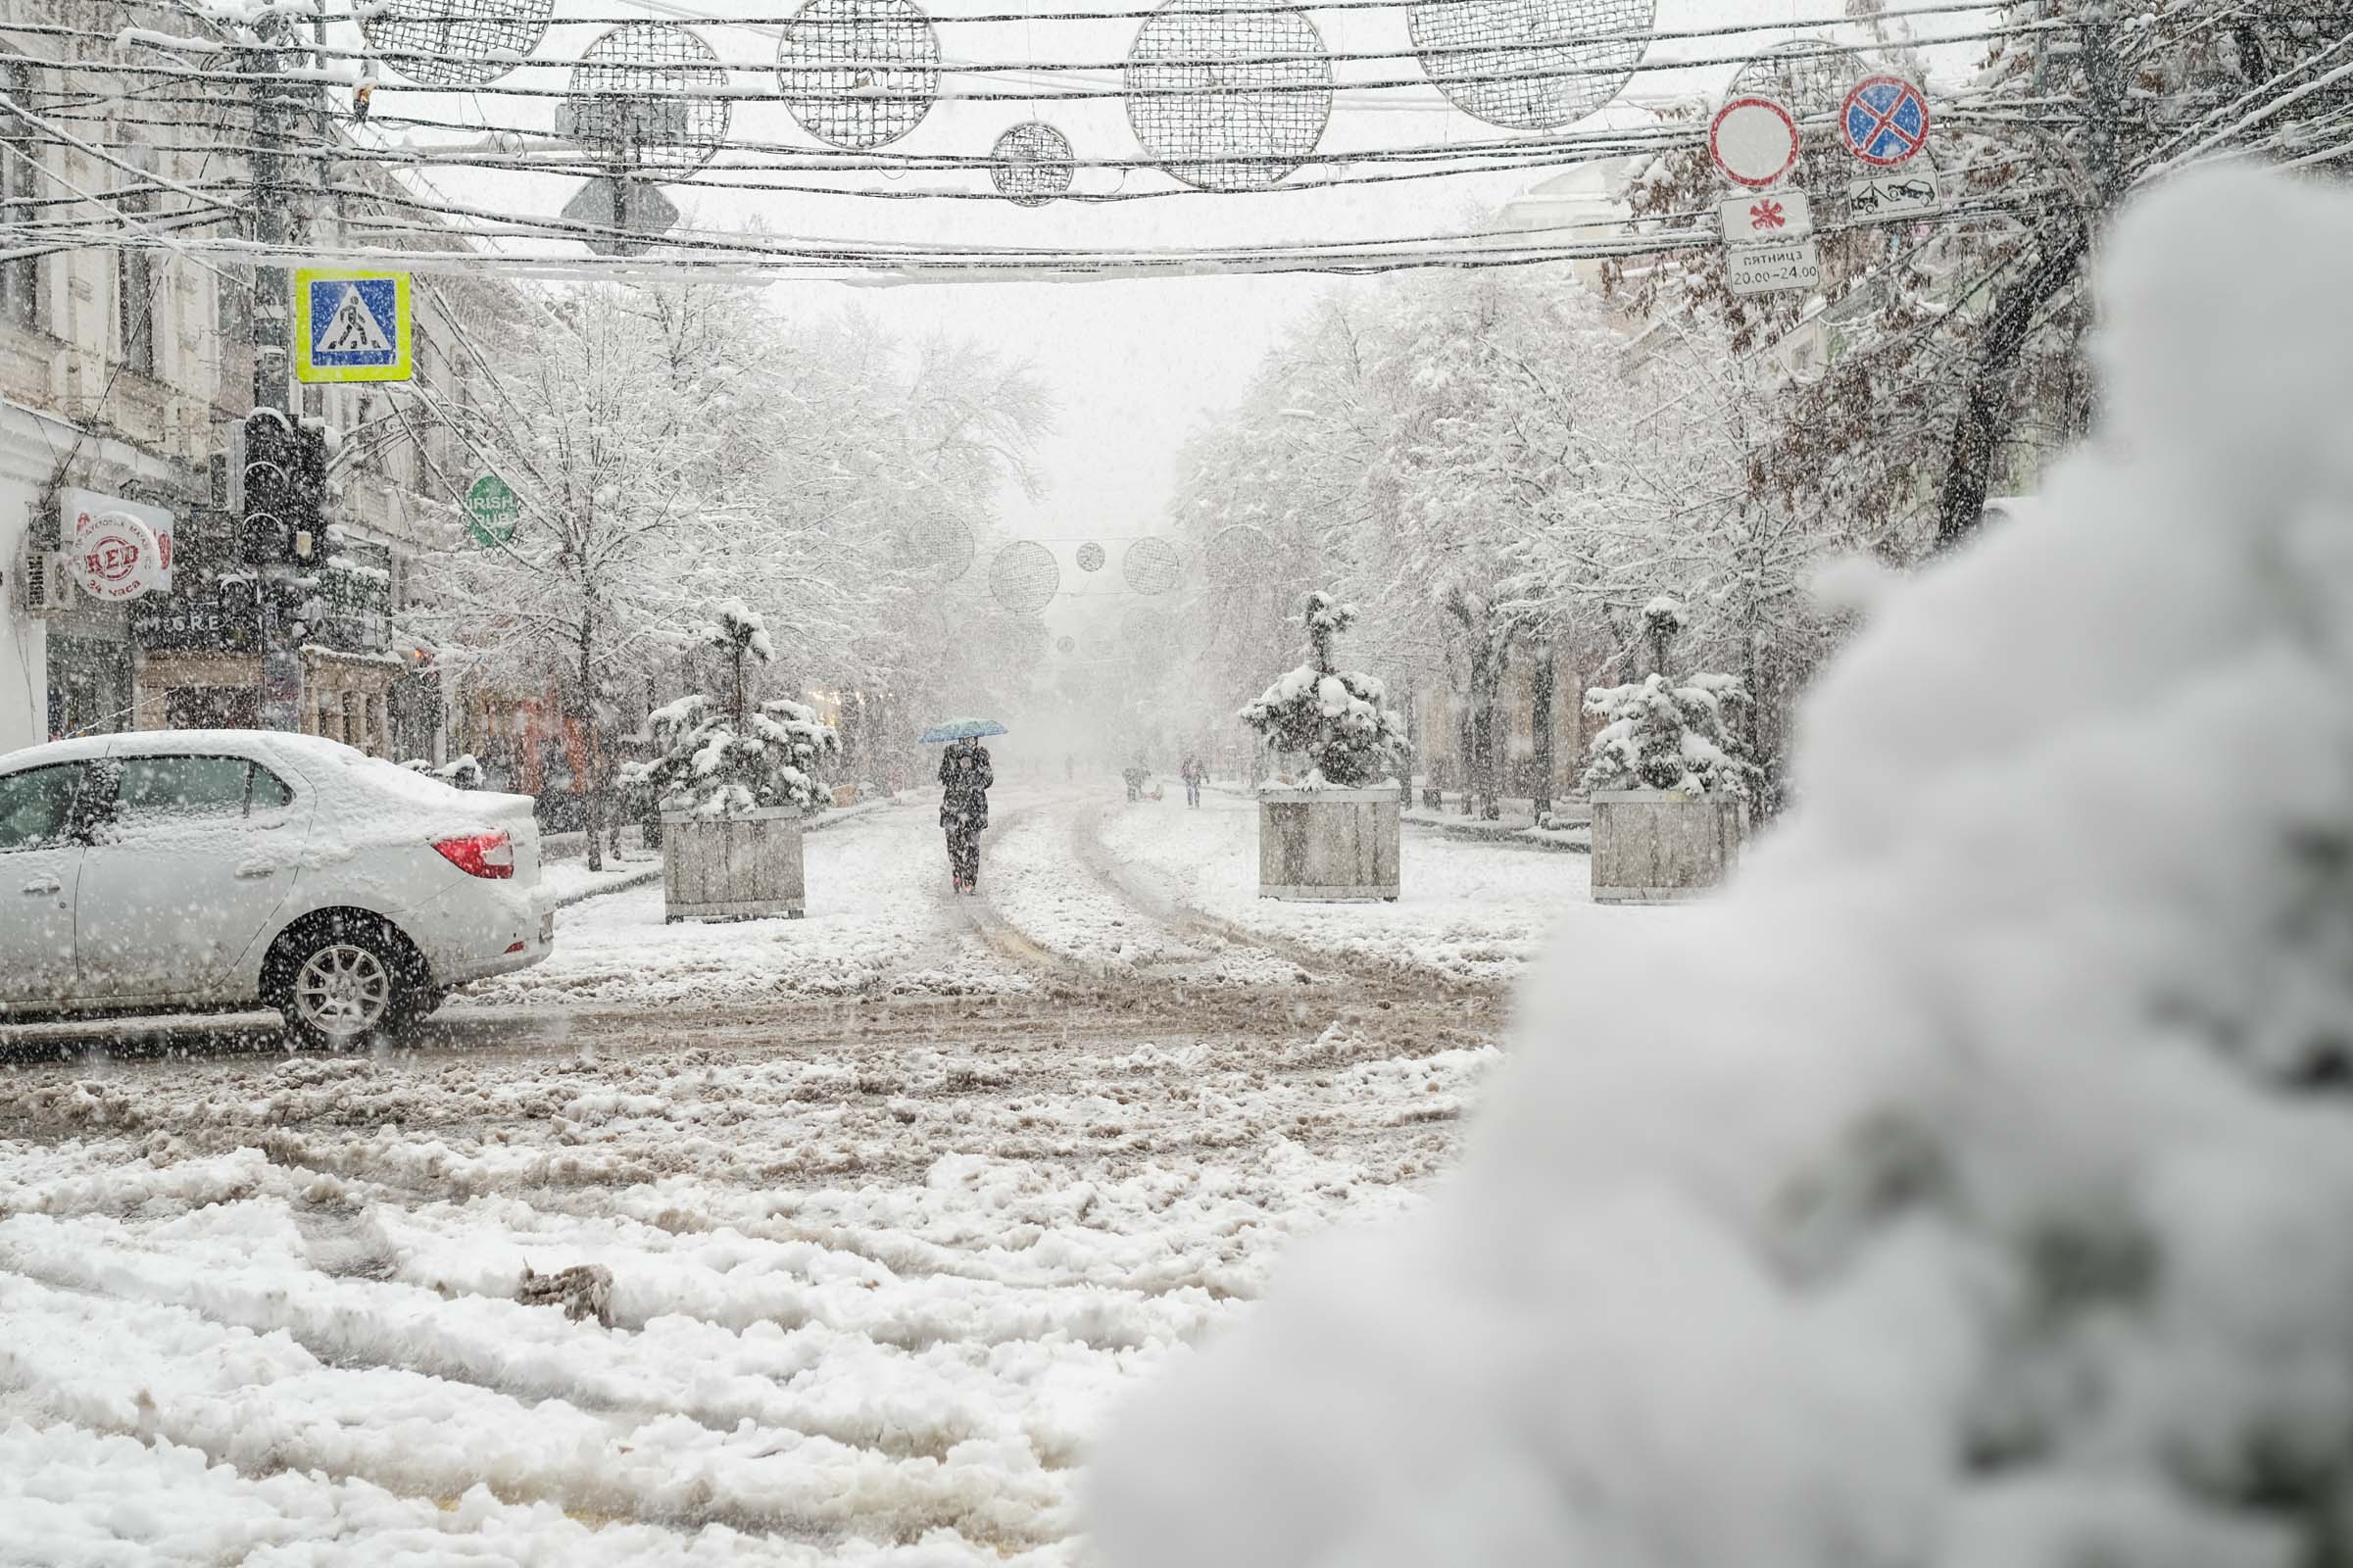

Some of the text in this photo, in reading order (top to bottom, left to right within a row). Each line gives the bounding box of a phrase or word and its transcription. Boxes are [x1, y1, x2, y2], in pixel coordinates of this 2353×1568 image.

[1743, 251, 1802, 266] ПЯТНИЦА
[469, 496, 513, 511] IRISH
[472, 514, 510, 529] PUB
[85, 545, 139, 573] RED
[87, 579, 141, 597] 24 часа
